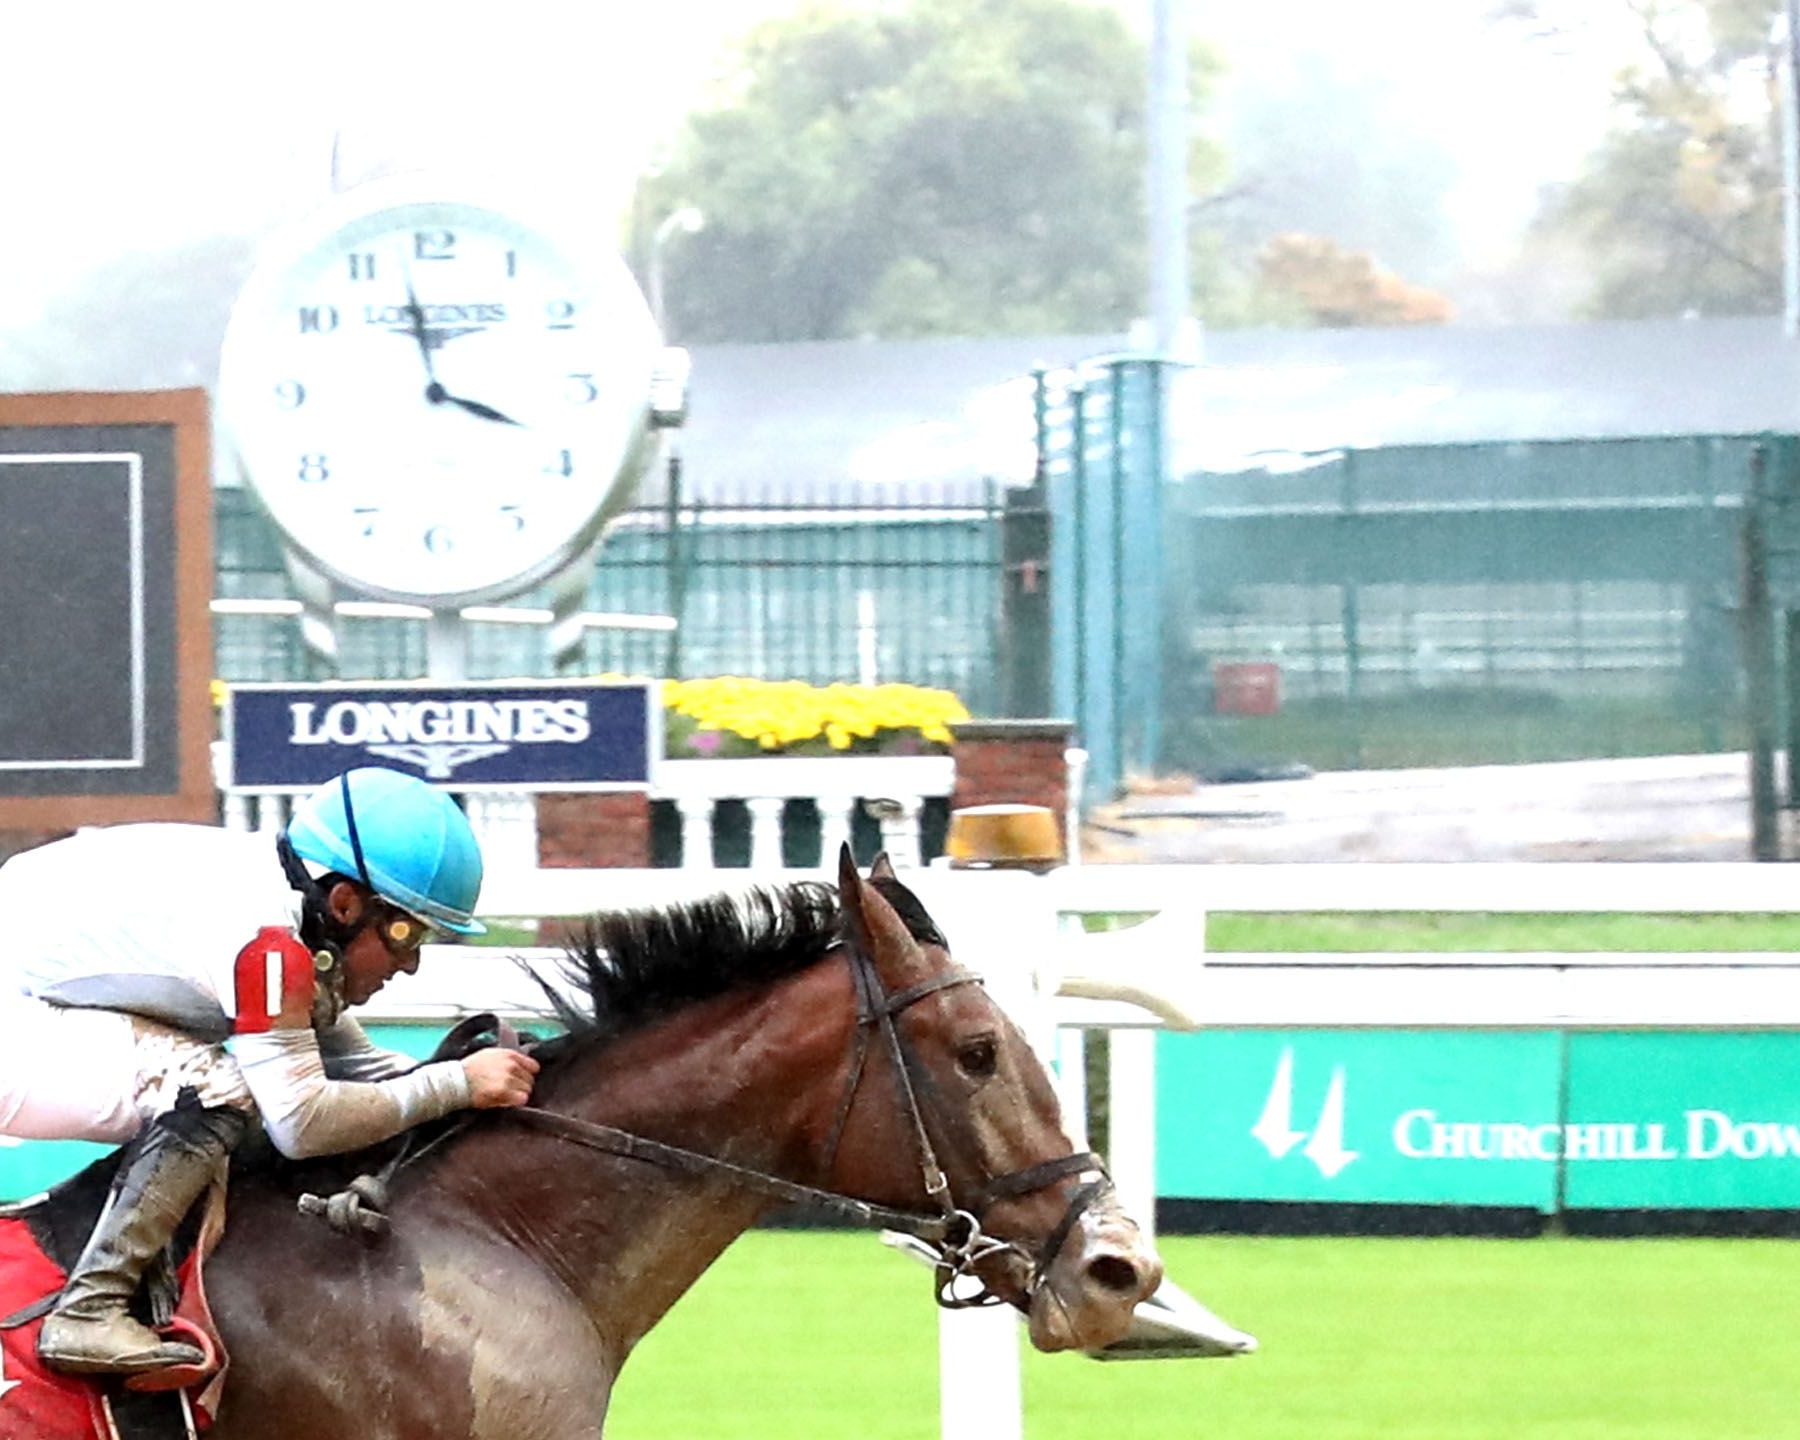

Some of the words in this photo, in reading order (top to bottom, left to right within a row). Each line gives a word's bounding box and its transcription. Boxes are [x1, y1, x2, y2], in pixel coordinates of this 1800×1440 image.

[413, 231, 456, 260] 12
[348, 253, 377, 280] 11
[299, 305, 339, 333] 10
[546, 301, 575, 329] 2
[274, 380, 306, 408] 9
[567, 373, 597, 405] 3
[298, 453, 329, 483] 8
[541, 449, 573, 479] 4
[423, 526, 454, 555] 6
[290, 699, 590, 744] LONGINES
[1393, 1109, 1678, 1160] CHURCHILL
